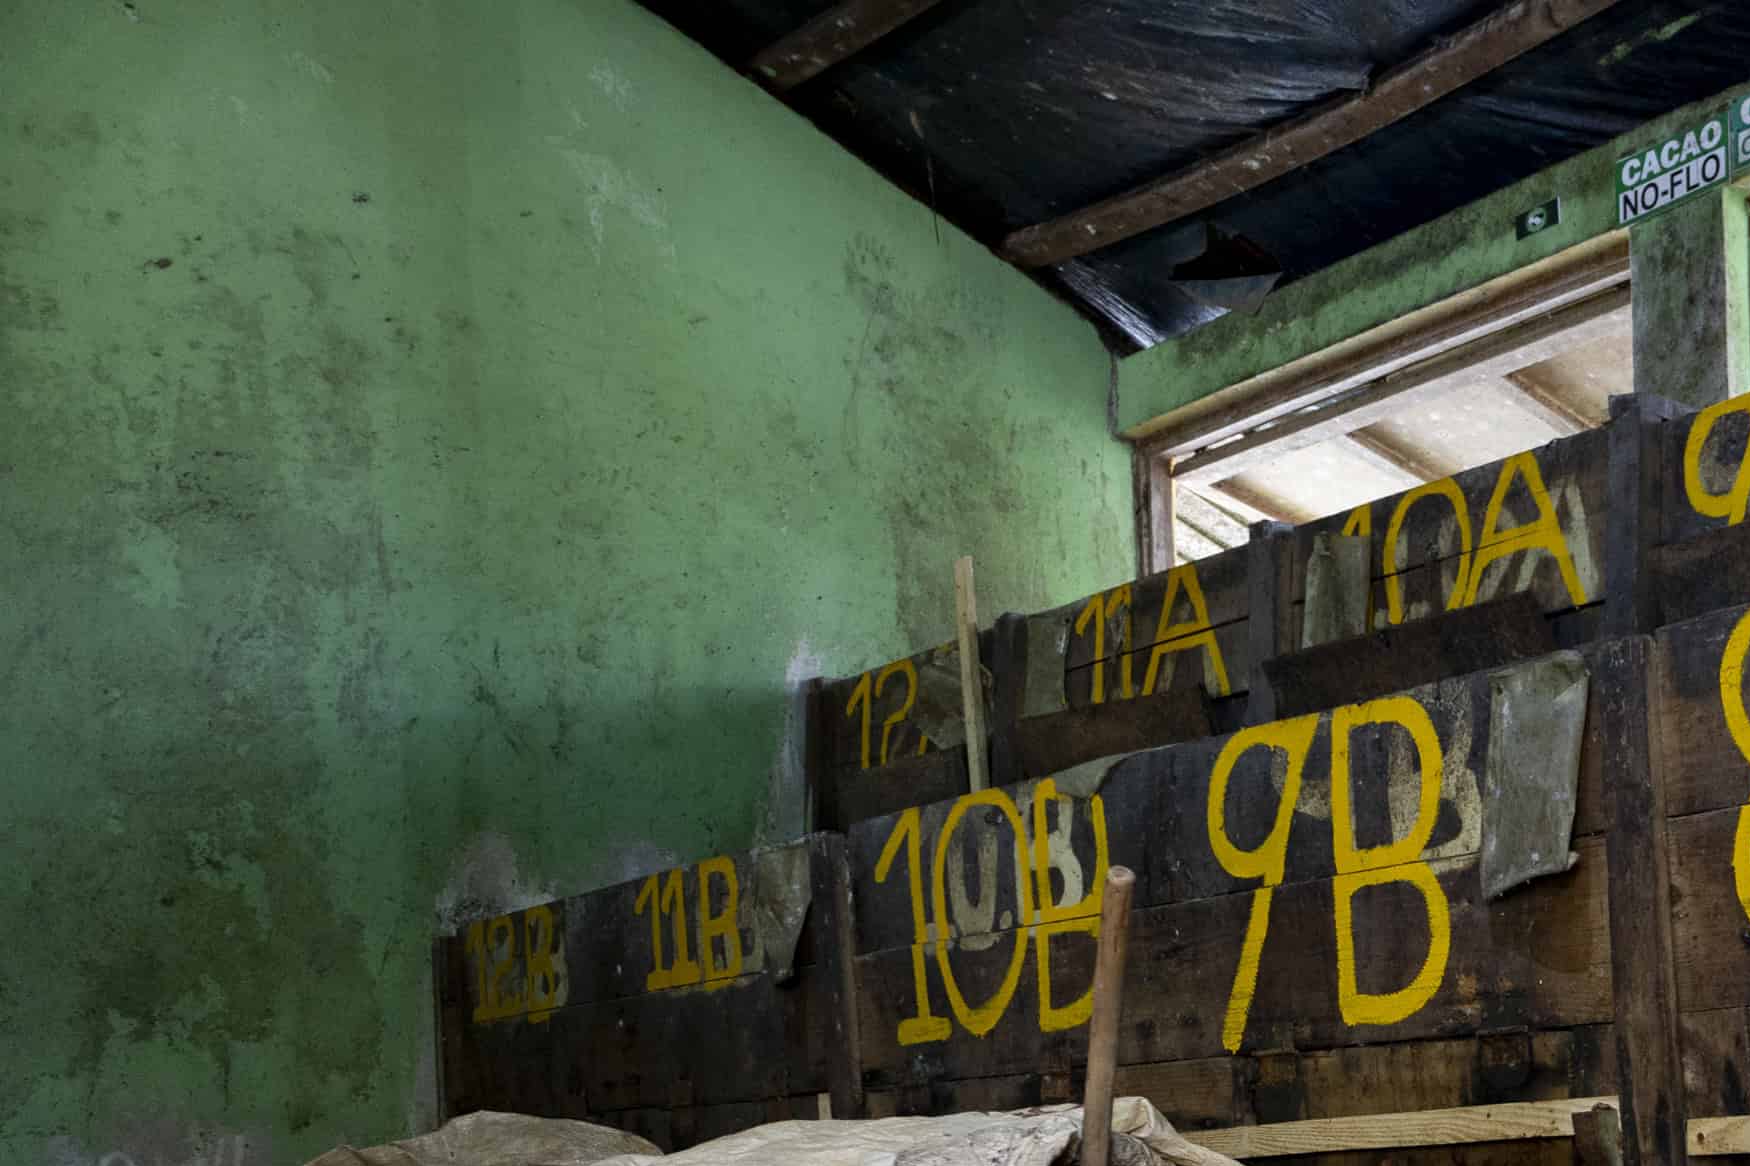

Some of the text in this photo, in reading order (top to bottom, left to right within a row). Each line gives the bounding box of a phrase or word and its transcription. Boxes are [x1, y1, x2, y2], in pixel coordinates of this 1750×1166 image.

[1620, 118, 1724, 187] CACAO
[1621, 153, 1721, 221] NO-FLO
[1075, 564, 1231, 704] 11A
[633, 853, 745, 994] 11B
[874, 777, 1112, 1047] 10B
[1206, 695, 1451, 1056] 9B
[464, 904, 558, 1026] 12B
